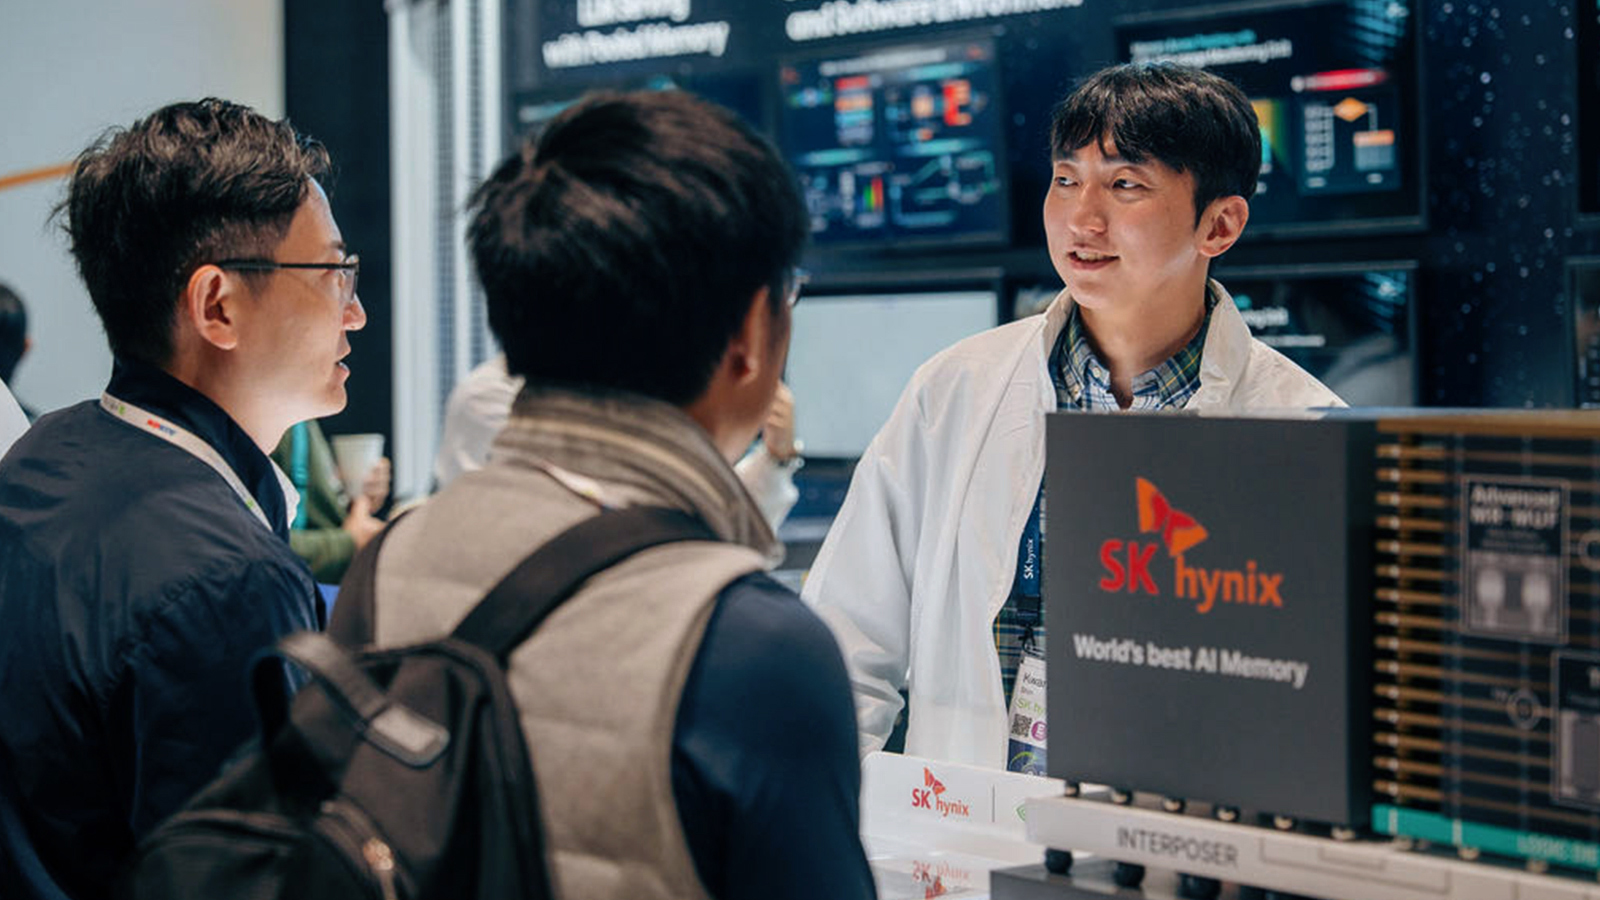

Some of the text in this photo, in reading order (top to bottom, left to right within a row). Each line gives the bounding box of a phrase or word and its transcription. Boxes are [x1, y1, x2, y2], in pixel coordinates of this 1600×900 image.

[1023, 538, 1036, 580] SK hynix
[1099, 539, 1284, 614] SK hynix
[1073, 633, 1309, 689] World's best AI Memory
[912, 788, 969, 817] SK hynix
[1117, 827, 1239, 866] INTERPOSER
